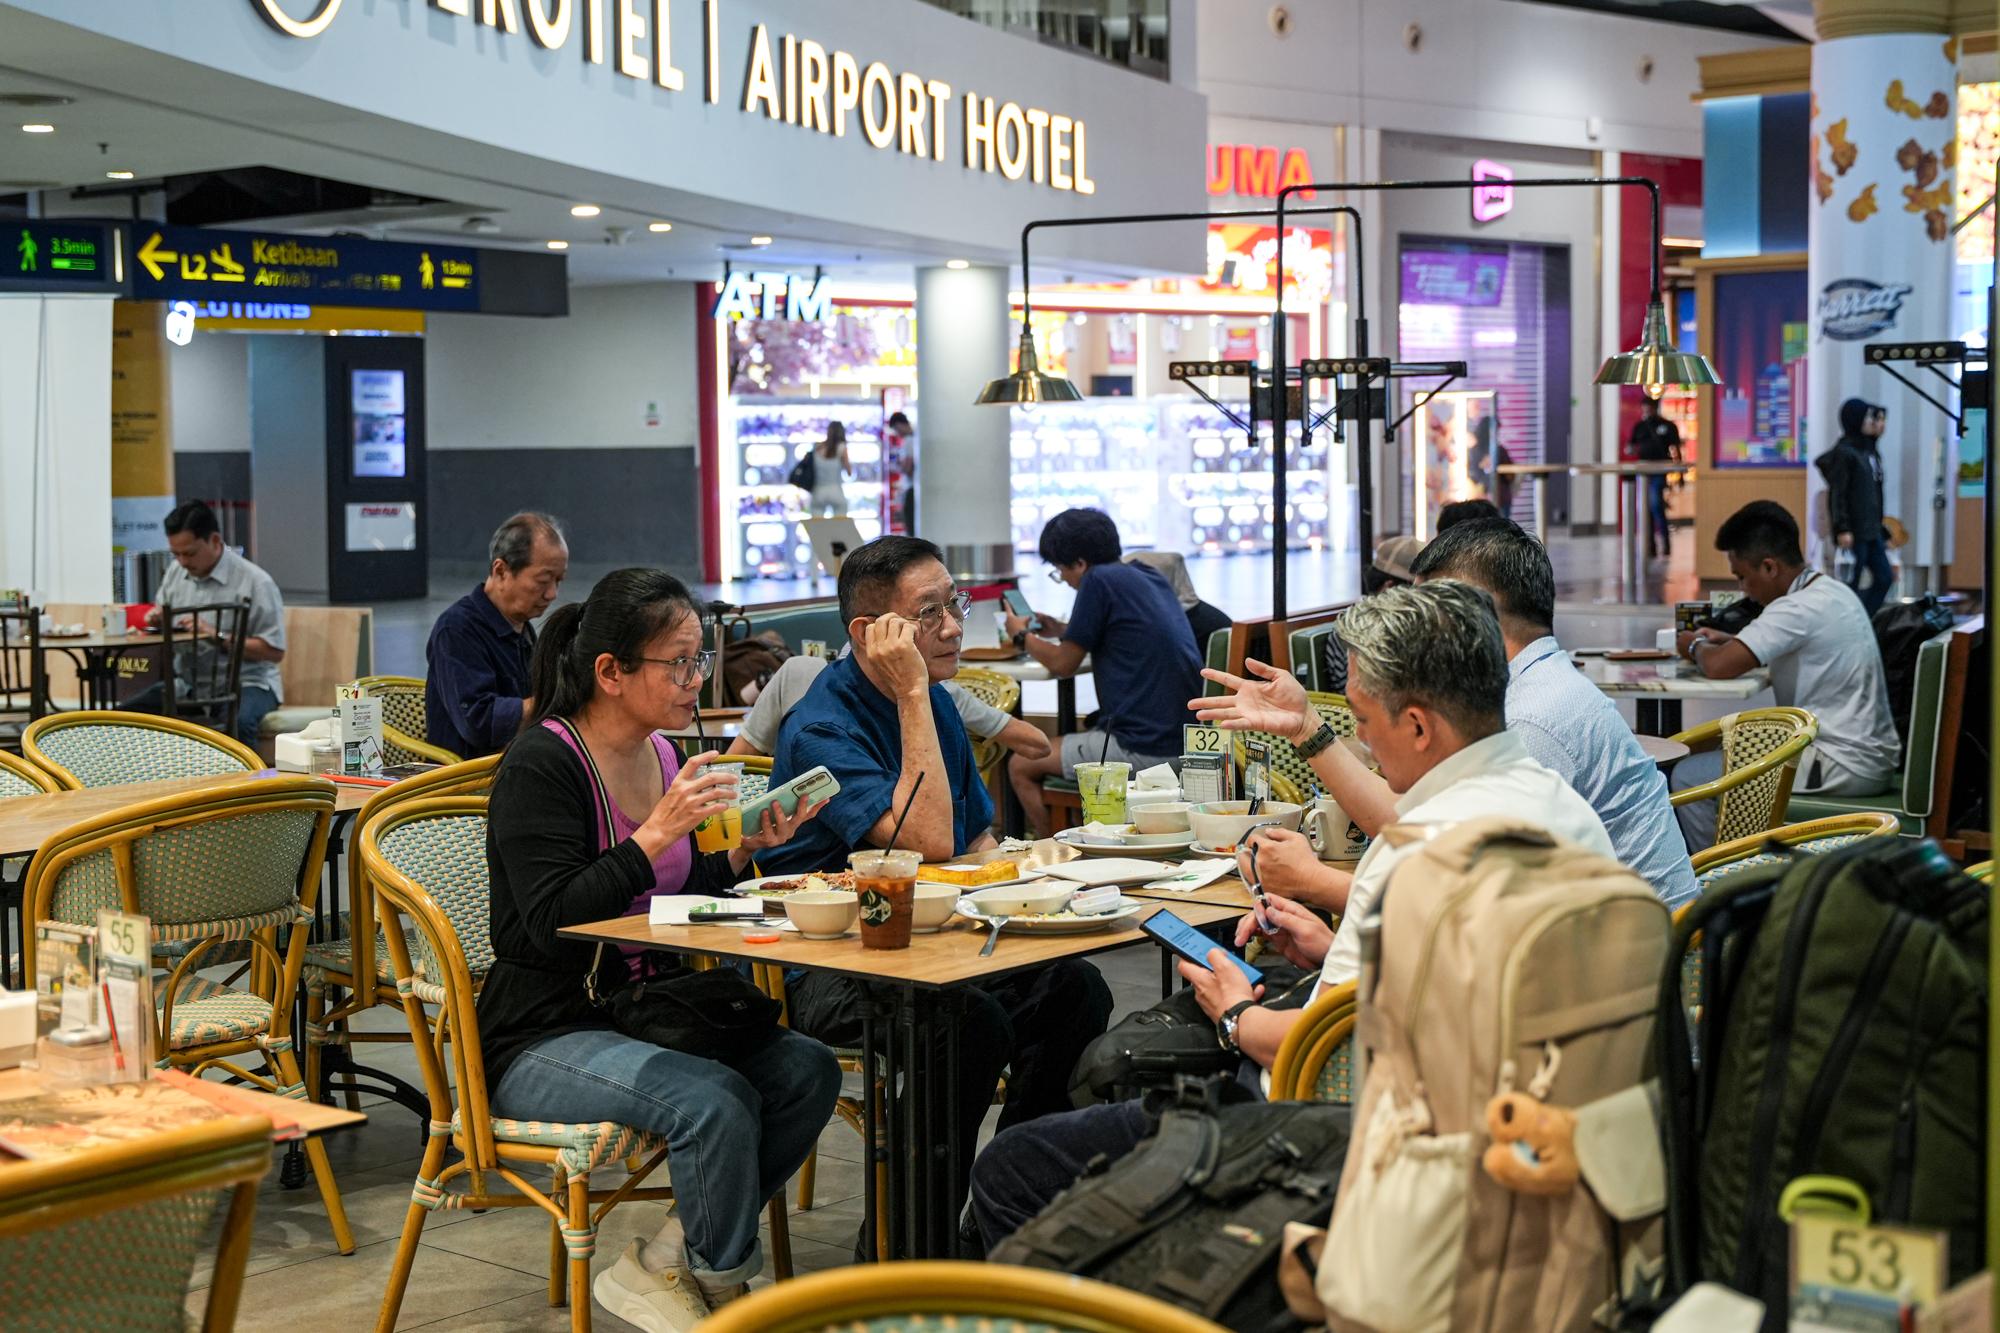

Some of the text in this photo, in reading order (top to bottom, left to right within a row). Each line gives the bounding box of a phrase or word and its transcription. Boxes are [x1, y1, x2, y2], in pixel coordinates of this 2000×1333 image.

[743, 22, 951, 162] AIRPORT
[965, 91, 1095, 195] HOTEL
[180, 254, 208, 280] L2
[252, 239, 339, 267] Ketibaan
[713, 271, 833, 322] ATM
[1194, 730, 1220, 752] 32
[109, 919, 136, 956] 55
[1828, 1229, 1902, 1292] 53
